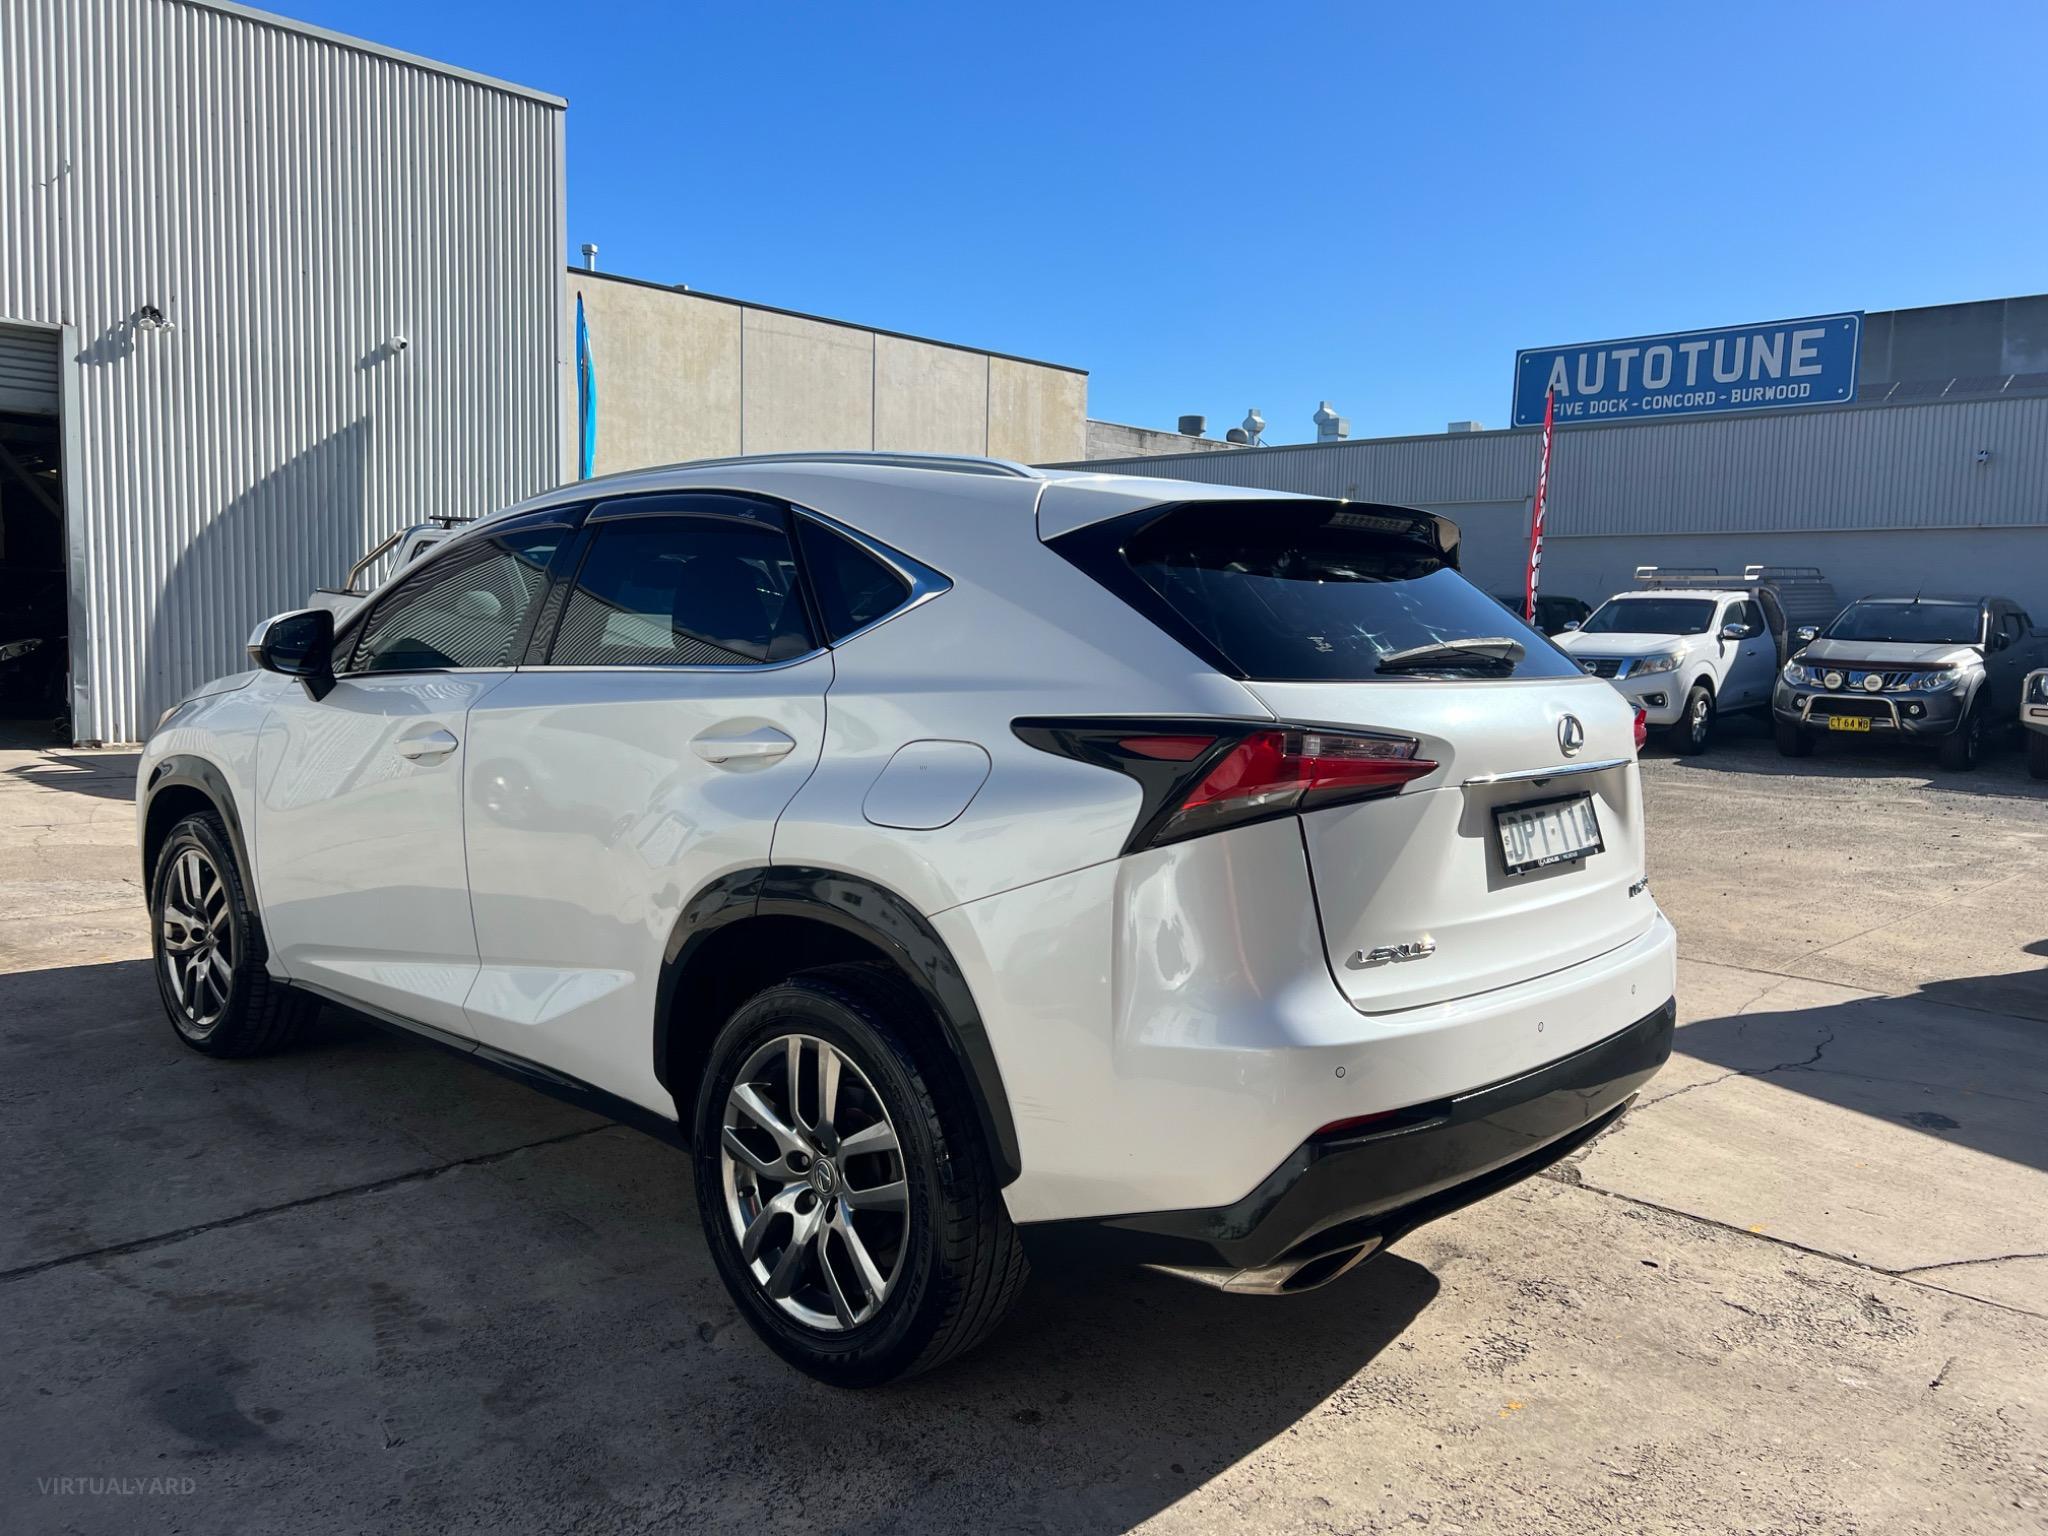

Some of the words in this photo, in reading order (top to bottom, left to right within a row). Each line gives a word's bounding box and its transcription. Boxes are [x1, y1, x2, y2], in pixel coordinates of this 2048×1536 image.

[1544, 327, 1826, 399] AUTOTUNE
[1589, 398, 1629, 415] DOCK
[1642, 391, 1716, 410] CONCORD
[1731, 383, 1811, 404] BURWOOD
